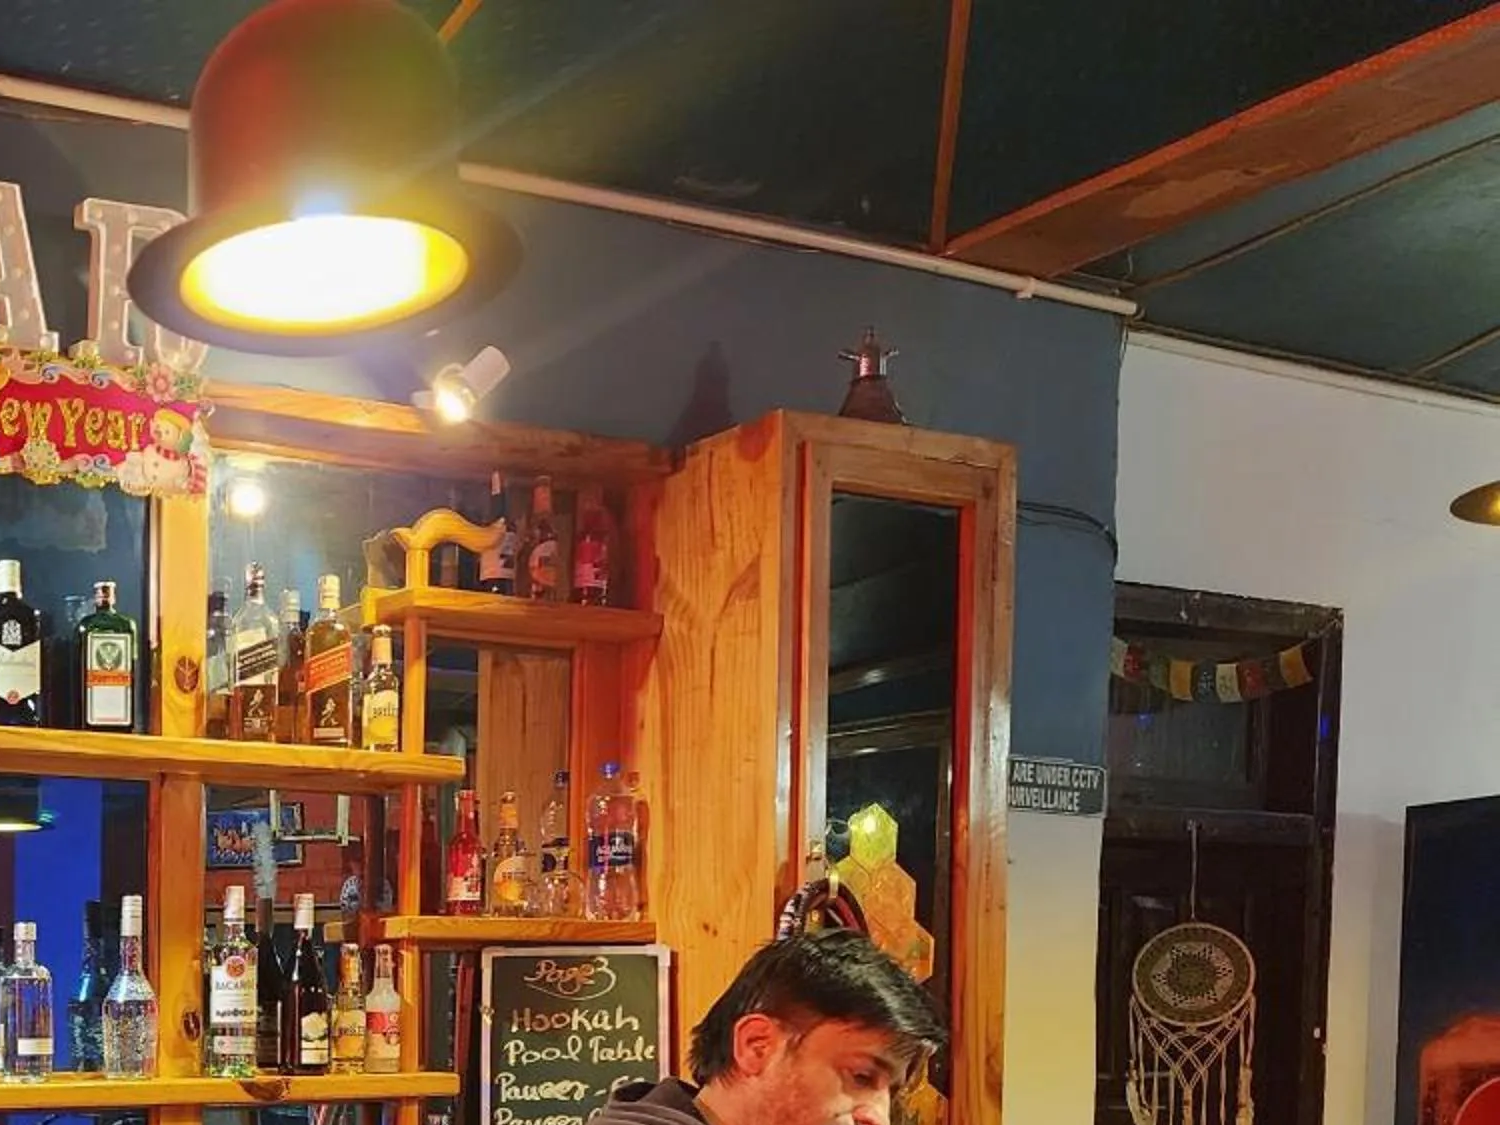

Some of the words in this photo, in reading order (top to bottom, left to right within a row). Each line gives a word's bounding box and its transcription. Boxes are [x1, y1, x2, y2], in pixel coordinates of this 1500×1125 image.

[55, 397, 148, 451] Year
[1071, 767, 1101, 789] CCTV
[1007, 785, 1081, 812] URVEILLANCE
[511, 1004, 640, 1033] Hookah
[503, 1035, 583, 1067] Pool
[589, 1035, 656, 1064] Table
